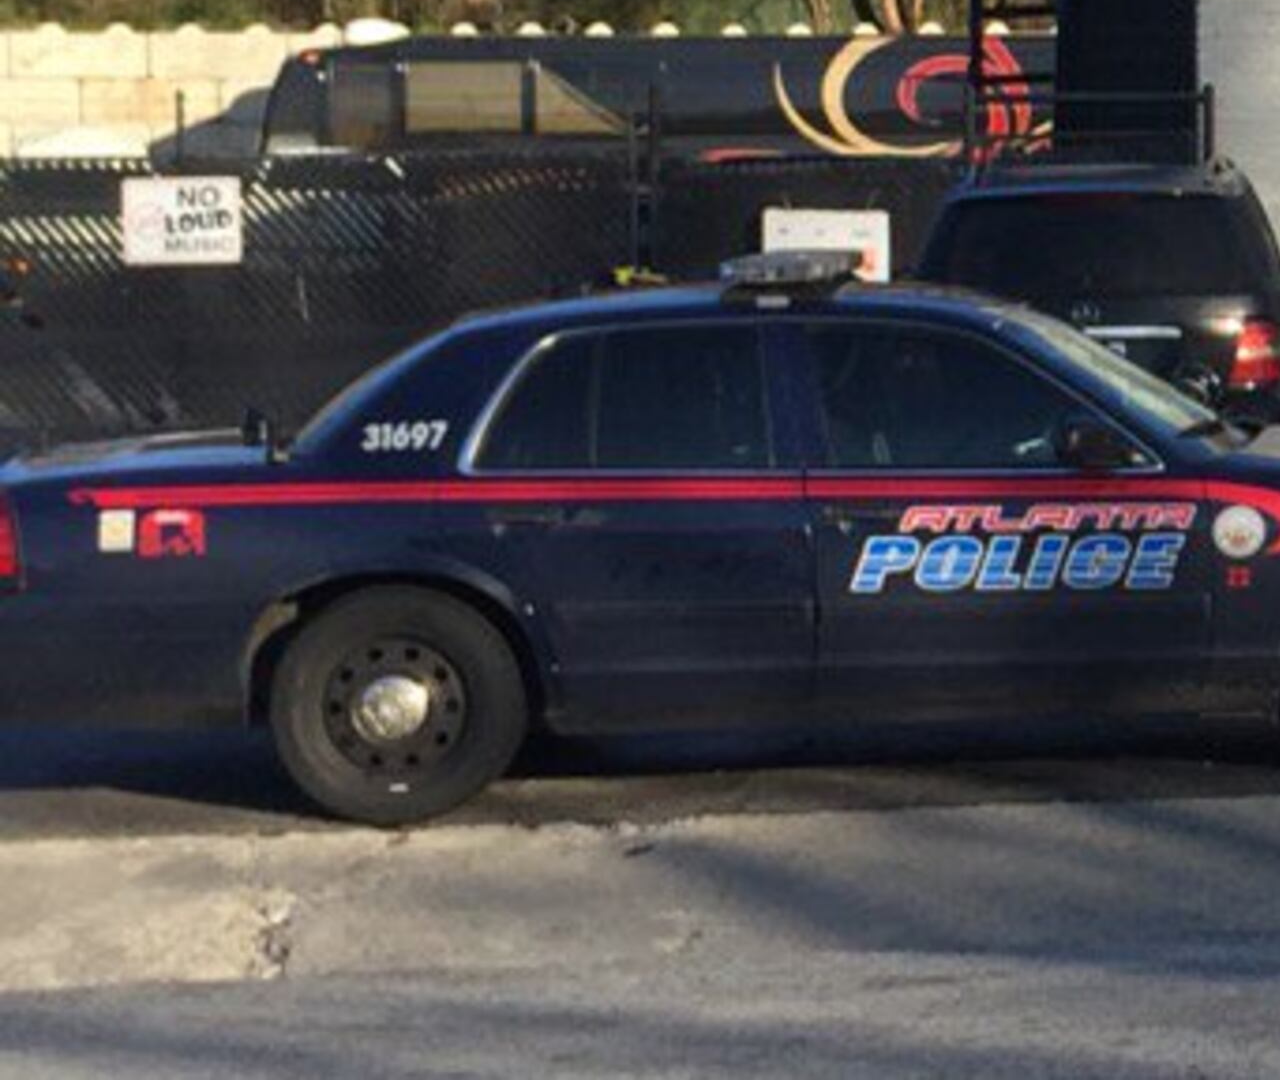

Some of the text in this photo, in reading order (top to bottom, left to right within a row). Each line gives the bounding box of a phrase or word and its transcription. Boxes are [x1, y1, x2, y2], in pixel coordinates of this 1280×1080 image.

[176, 185, 221, 209] NO
[164, 209, 233, 235] LOUD
[361, 420, 448, 452] 31697
[899, 503, 1197, 533] ATLANTA
[848, 534, 1186, 593] POLICE
